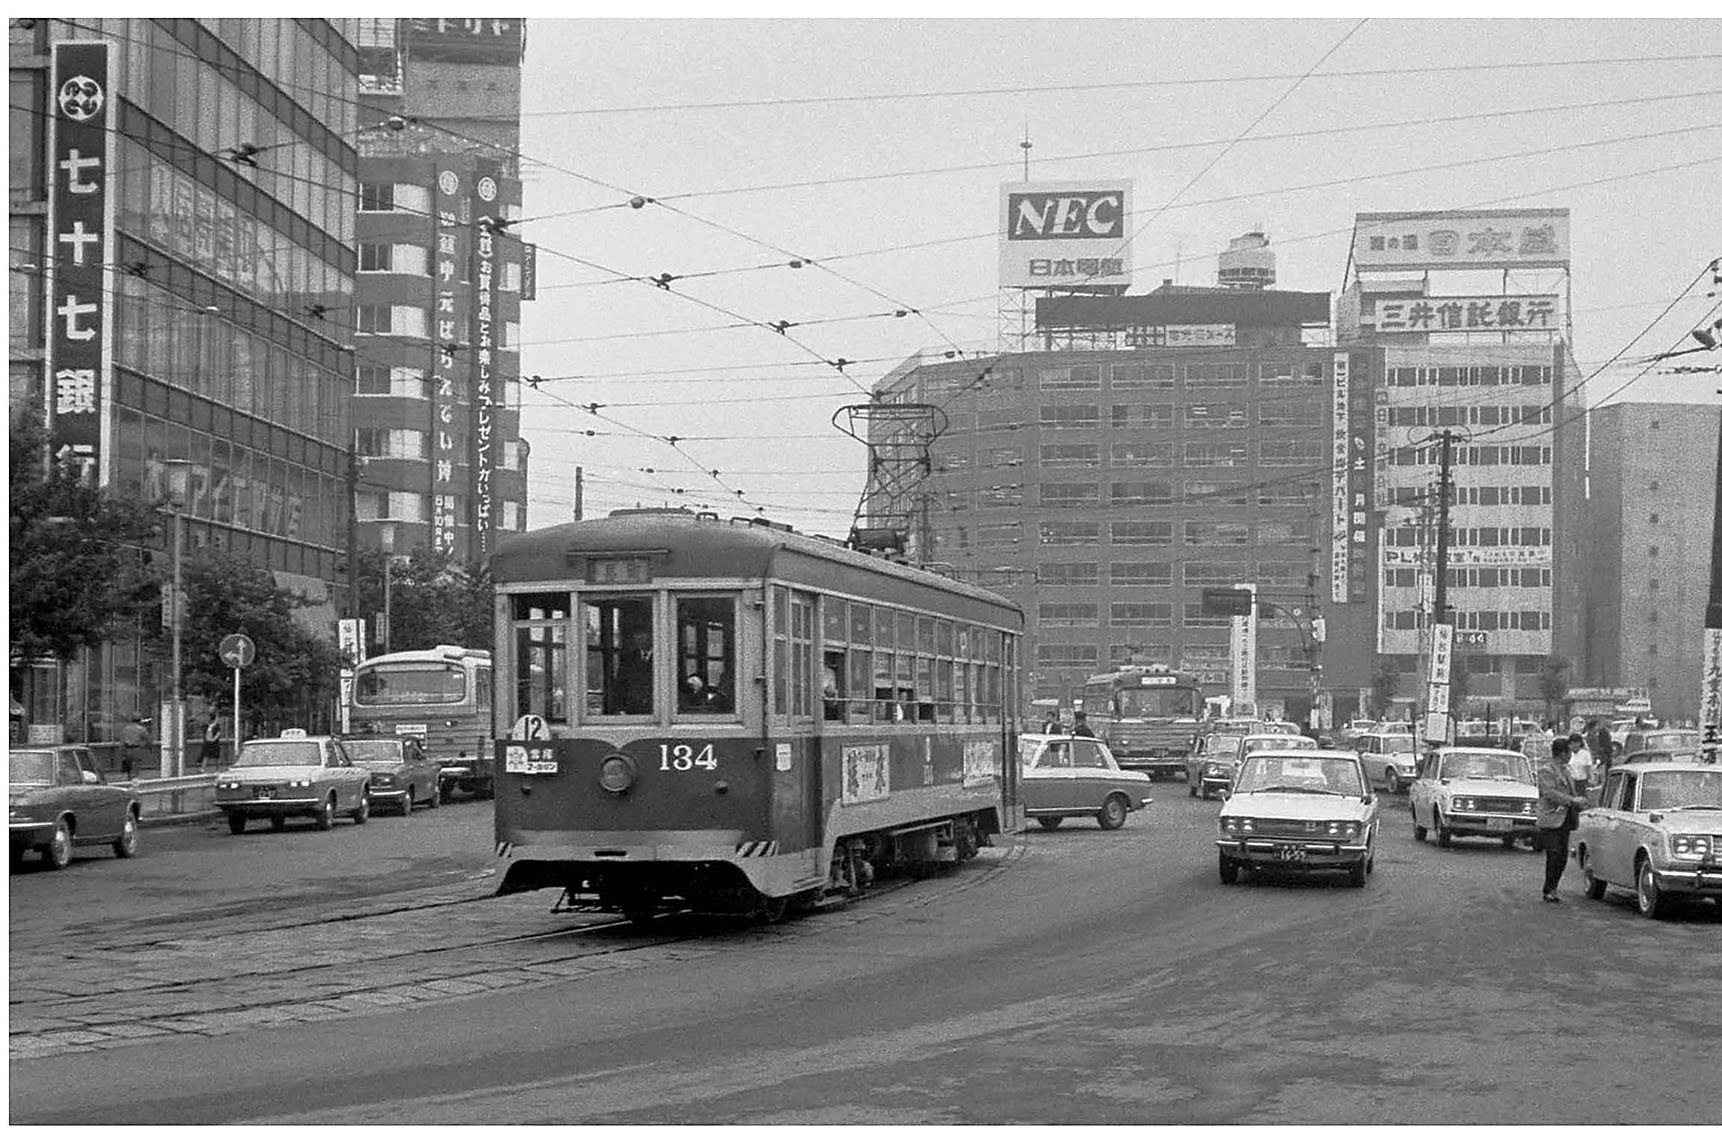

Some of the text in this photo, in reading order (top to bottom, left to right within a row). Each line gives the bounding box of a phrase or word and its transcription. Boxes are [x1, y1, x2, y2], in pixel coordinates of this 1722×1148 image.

[1015, 195, 1119, 236] NEC
[55, 148, 101, 484] 七十七銀行
[1380, 300, 1554, 329] 三井信託銀行
[523, 716, 542, 740] 12
[659, 744, 718, 771] 134
